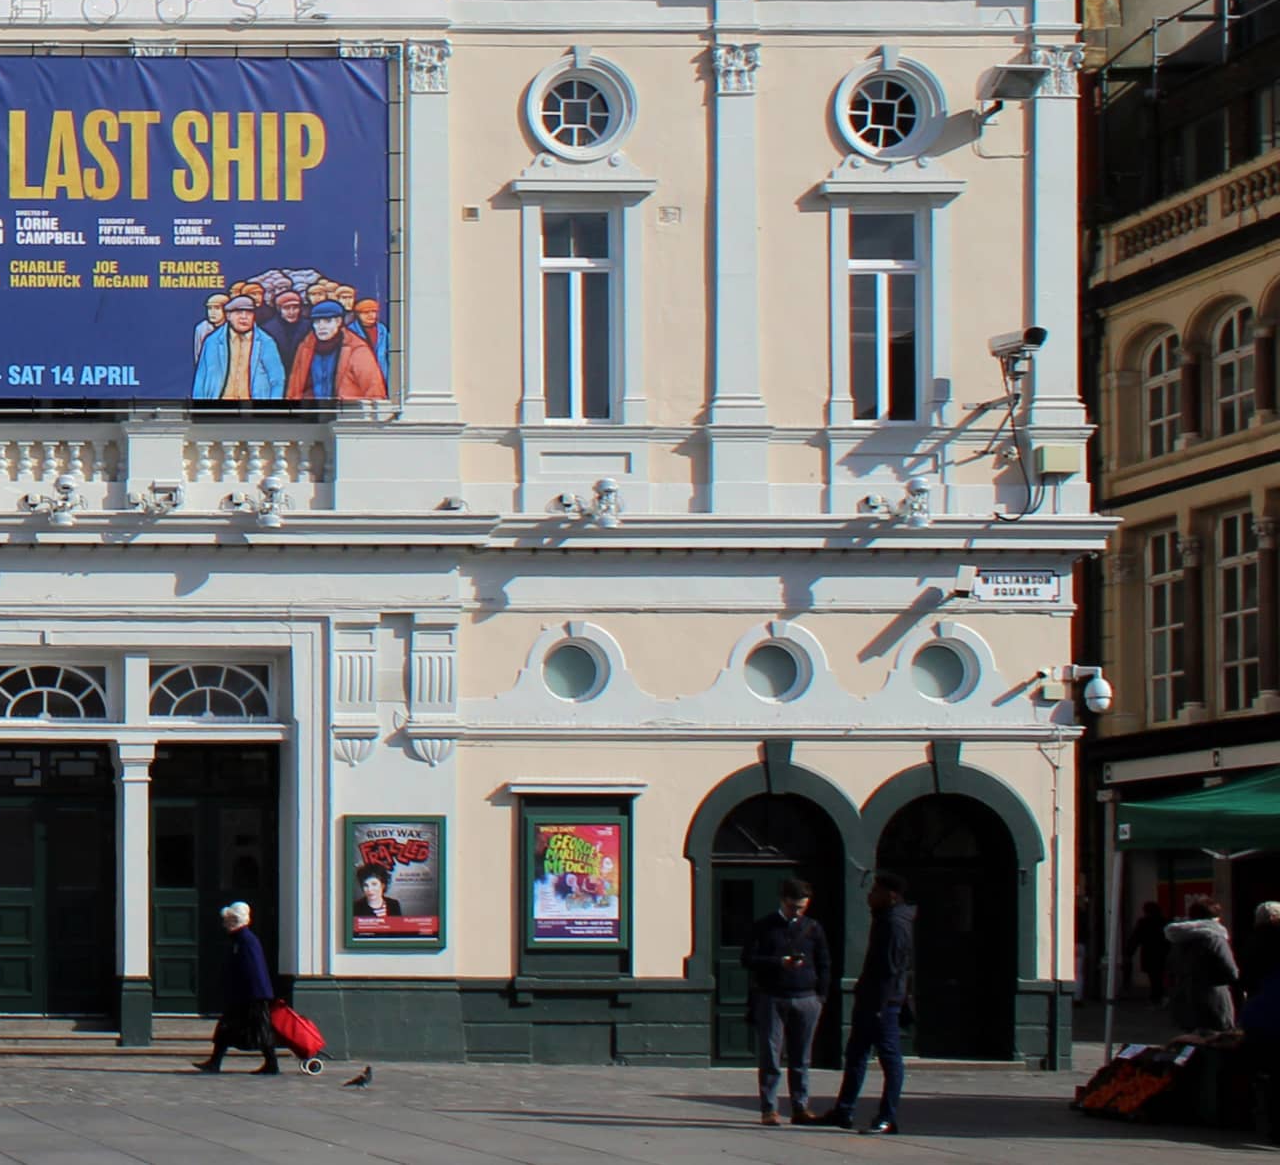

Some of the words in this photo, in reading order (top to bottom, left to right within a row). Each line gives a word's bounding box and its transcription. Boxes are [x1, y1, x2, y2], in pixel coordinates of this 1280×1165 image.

[8, 109, 160, 200] LAST
[172, 110, 326, 202] SHIP
[16, 217, 59, 230] LORNE
[98, 226, 124, 235] FIFTY
[125, 226, 146, 235] NINE
[174, 226, 203, 235] LORNE
[16, 232, 86, 245] CAMPBELL
[98, 236, 161, 245] PRODUCTIONS
[174, 236, 222, 245] CAMPBELL
[10, 261, 66, 273] CHARLIE
[93, 261, 118, 273] JOE
[160, 261, 219, 274] FRANCES
[10, 275, 81, 287] HARDWICK
[93, 275, 148, 288] McGANN
[160, 275, 225, 288] McNAMEE
[8, 365, 45, 384] SAT
[51, 366, 74, 384] 14
[80, 365, 139, 385] APRIL
[981, 575, 1051, 584] WILLIAMSON
[993, 588, 1040, 596] SQUARE
[367, 829, 394, 838] RUBY
[396, 829, 422, 838] WAX
